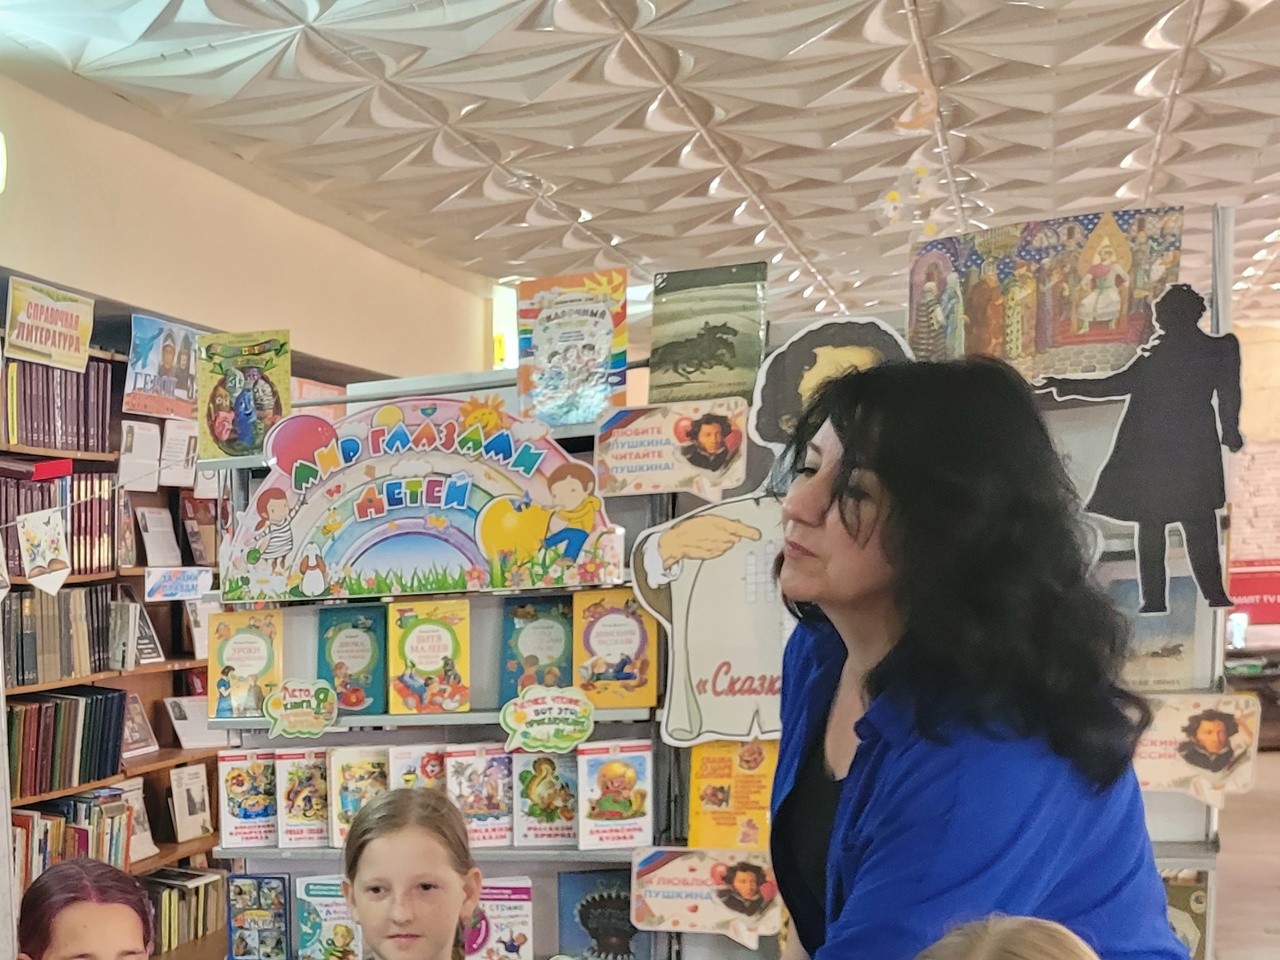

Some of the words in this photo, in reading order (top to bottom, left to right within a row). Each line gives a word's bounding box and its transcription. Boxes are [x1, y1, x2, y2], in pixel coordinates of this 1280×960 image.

[26, 301, 80, 331] СПРАВОЧНАЯ
[16, 321, 80, 354] ЛИТЕРАТУРА
[612, 427, 663, 437] ЛЮБИТЕ
[291, 437, 361, 494] МИР
[368, 419, 549, 478] ГЛАЗАМИ
[353, 472, 473, 522] ДЕТЕЙ
[644, 889, 712, 900] ПУШКИНА
